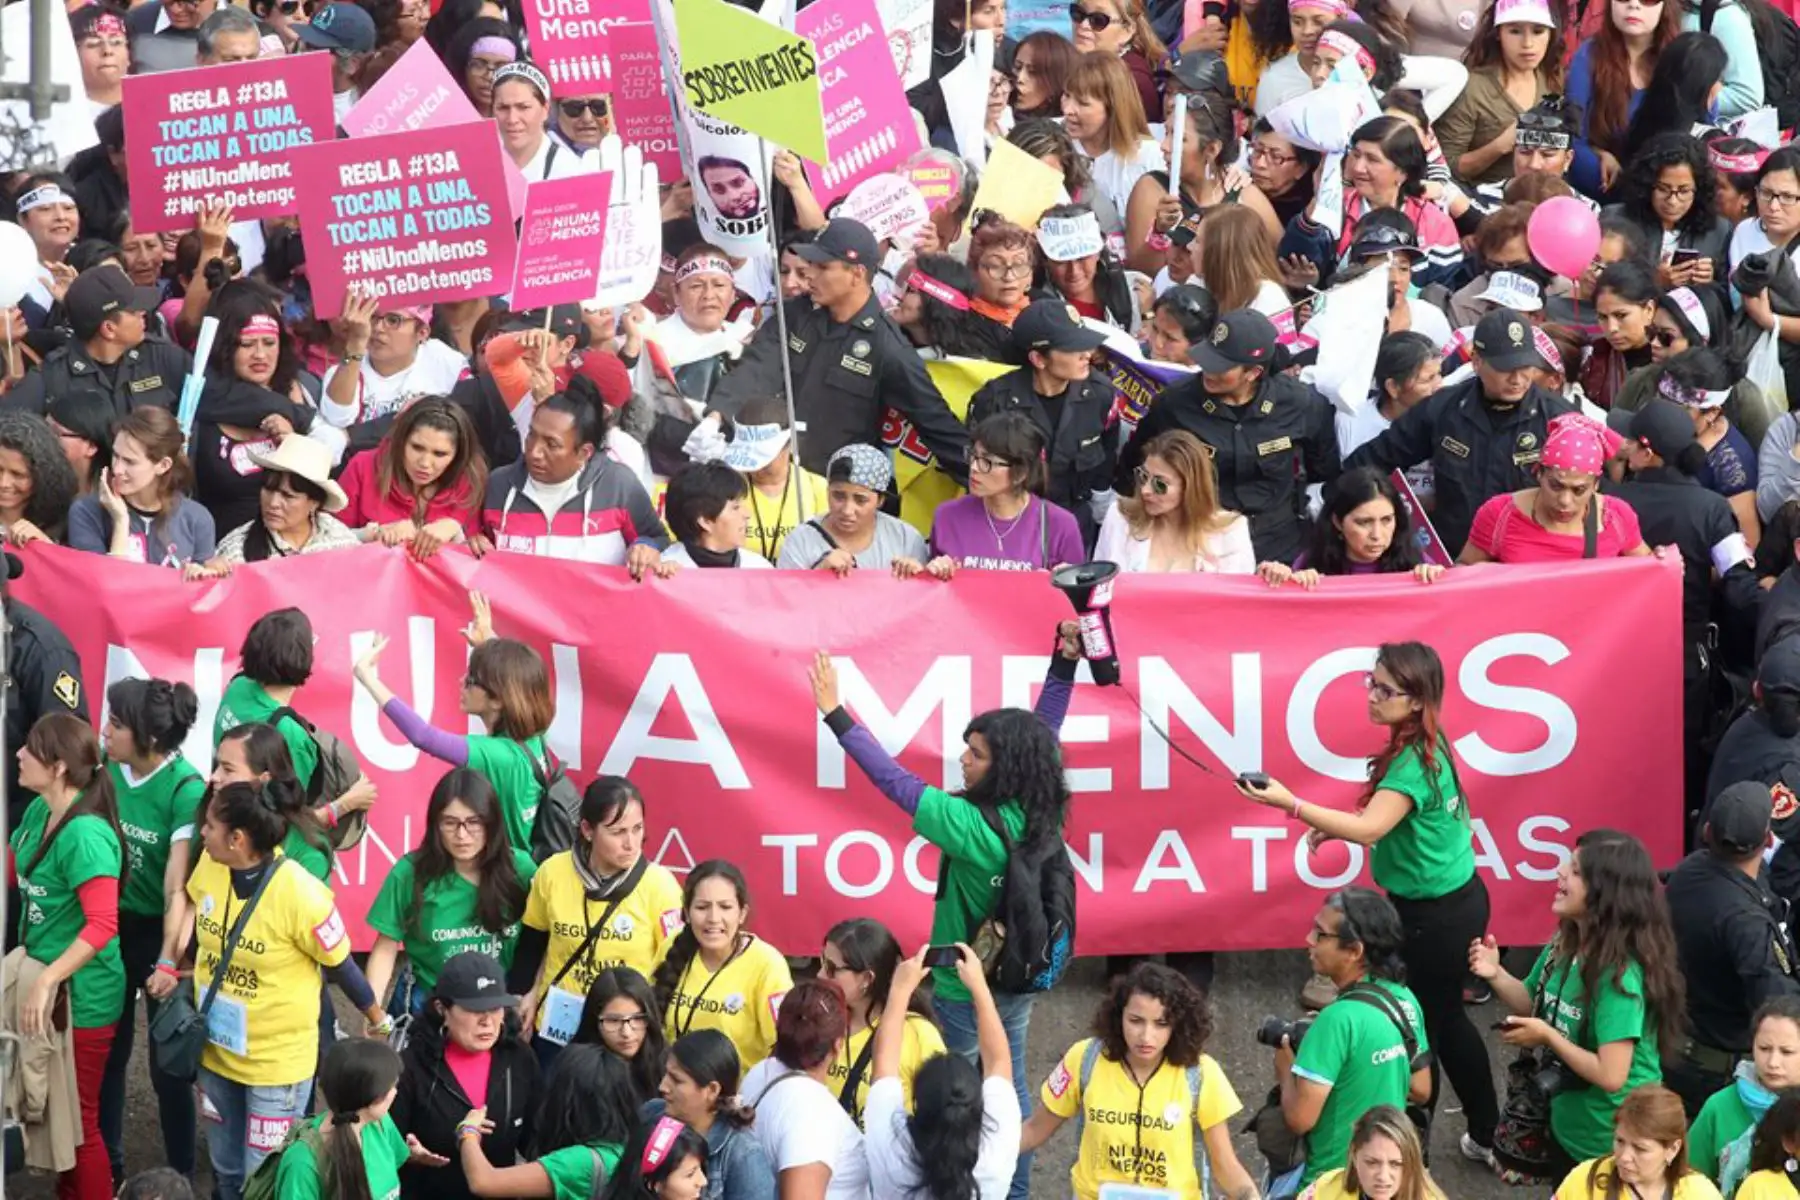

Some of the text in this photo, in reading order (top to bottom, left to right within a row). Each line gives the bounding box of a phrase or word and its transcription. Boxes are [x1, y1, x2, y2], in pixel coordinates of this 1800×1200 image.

[539, 17, 628, 41] Meno
[169, 79, 288, 113] REGLA #13A
[158, 114, 228, 142] TOCAN
[233, 111, 248, 132] A
[152, 127, 314, 167] TOCAN A TODAS
[163, 160, 292, 193] #NiUnaMeno
[339, 150, 460, 187] REGLA #13A
[164, 186, 296, 217] #NoTeDetenga
[331, 187, 402, 218] TOCAN
[408, 185, 423, 208] A
[326, 203, 492, 247] TOCAN A TODAS
[342, 239, 489, 275] #NiUnaMenos
[346, 266, 493, 298] #NoTeDetengas
[523, 268, 592, 288] VIOLENCIA
[744, 525, 797, 538] EGURI
[817, 632, 1578, 792] MENOS
[761, 830, 1103, 899] TOCN
[1133, 830, 1207, 894] A
[1231, 815, 1572, 893] TOAS
[199, 914, 265, 955] SEGUDAD
[432, 923, 518, 941] COMUNICANES
[553, 921, 633, 943] SEGUDAD
[1088, 1108, 1174, 1131] SEGURDAD
